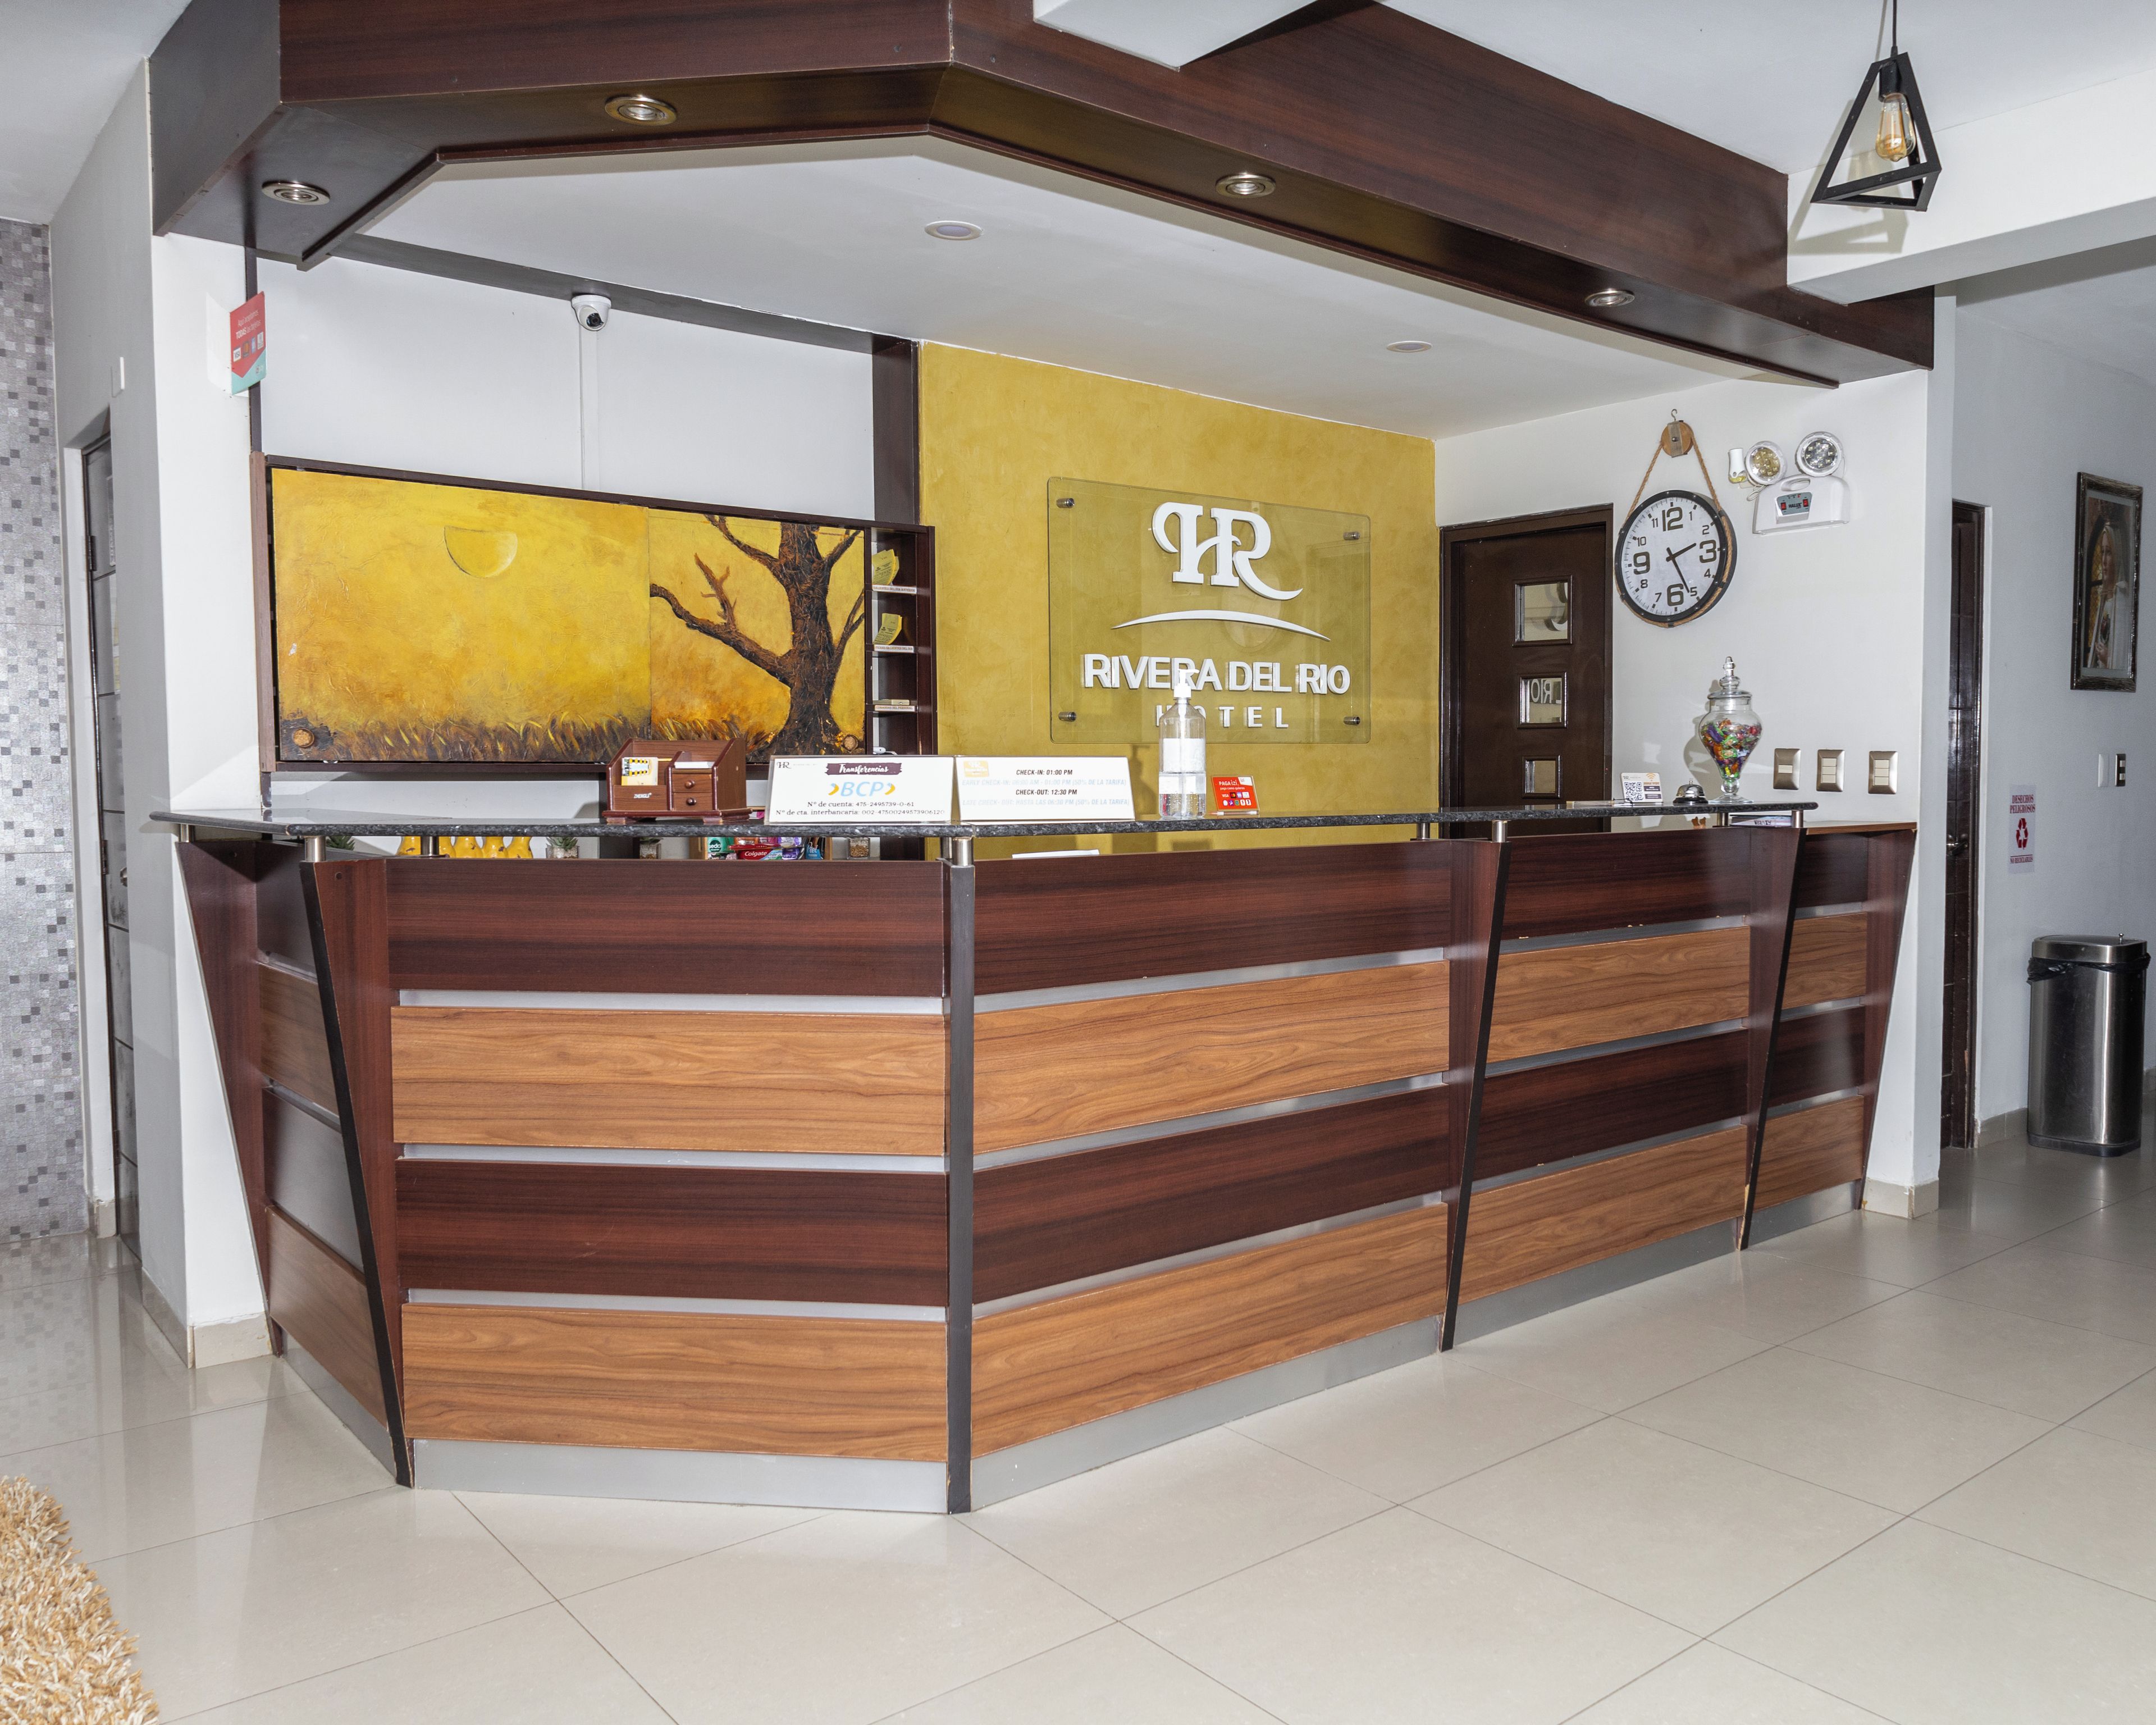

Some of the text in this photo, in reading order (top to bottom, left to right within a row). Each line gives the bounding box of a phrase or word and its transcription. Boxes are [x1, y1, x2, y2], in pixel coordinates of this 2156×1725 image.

[236, 327, 246, 340] TODAS
[1662, 506, 1683, 531] 12
[1689, 512, 1693, 521] 1
[1651, 518, 1659, 528] 11
[1702, 525, 1709, 535] 2
[1637, 536, 1646, 546] 10
[1152, 501, 1303, 601] HR
[1700, 540, 1717, 563] 3
[1633, 551, 1650, 575] 9
[1704, 568, 1711, 578] 4
[1640, 579, 1648, 588] 8
[1666, 583, 1684, 606] 6
[1690, 586, 1698, 596] 5
[1655, 592, 1662, 603] 7
[1084, 653, 1351, 694] RIVERA DEL RIO
[839, 763, 889, 774] Transferencias
[841, 781, 884, 797] BCP
[2012, 795, 2034, 804] DESECHOS
[2010, 804, 2035, 814] PELIGROSOS
